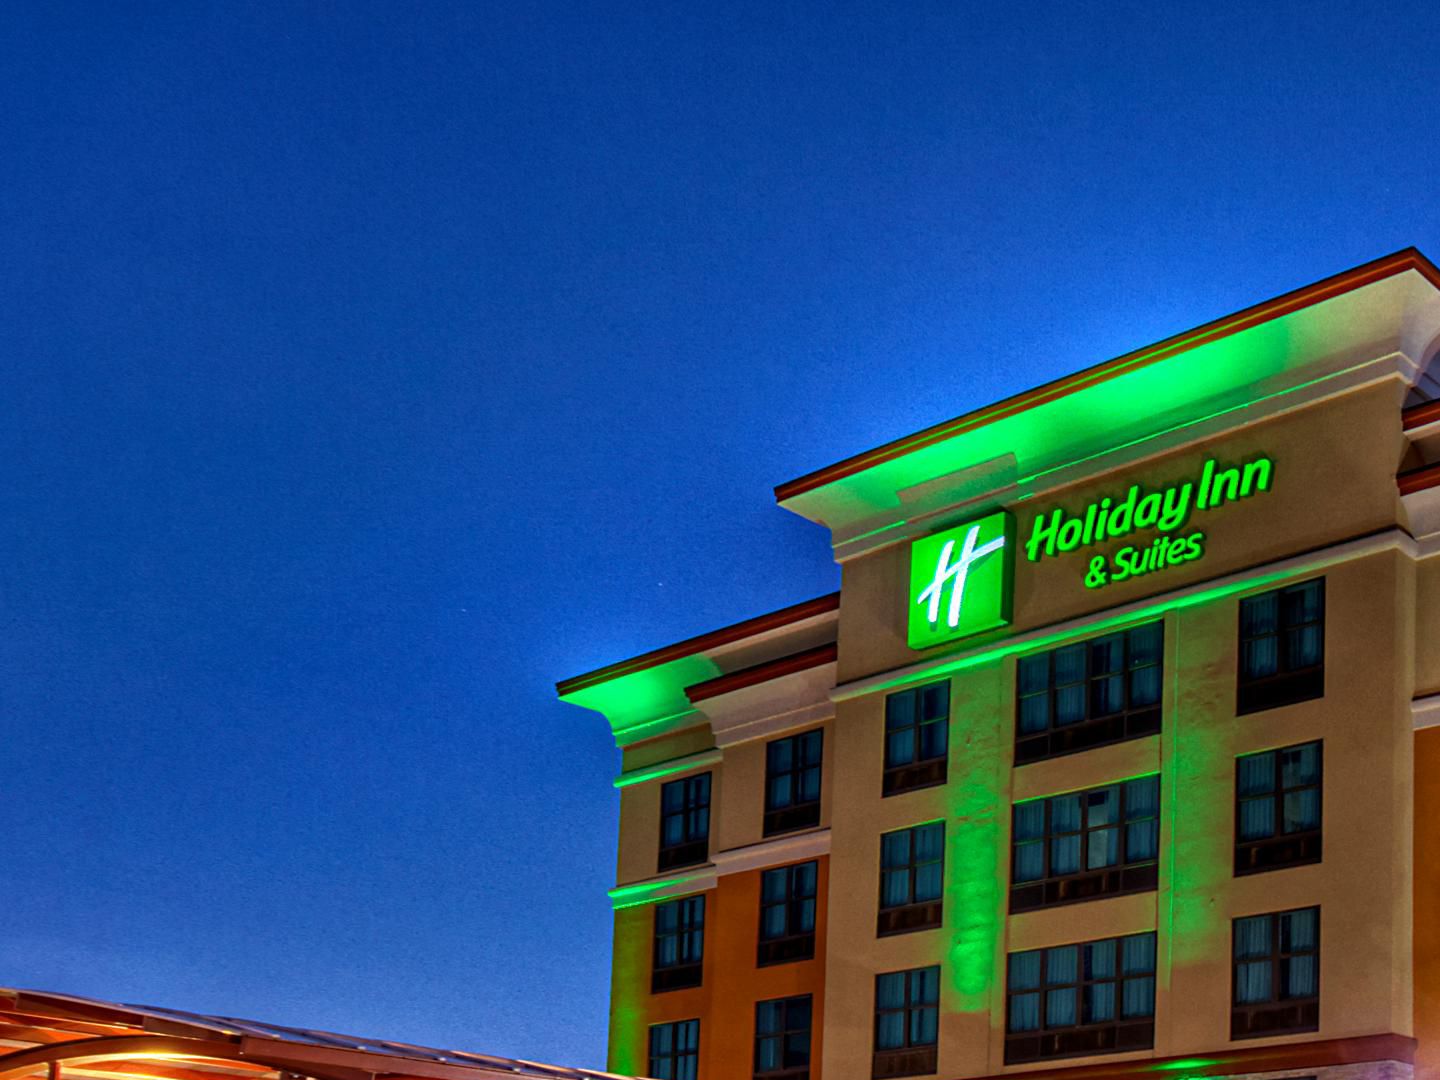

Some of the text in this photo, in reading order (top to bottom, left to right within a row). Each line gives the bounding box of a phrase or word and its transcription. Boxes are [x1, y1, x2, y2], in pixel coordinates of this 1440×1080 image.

[1025, 457, 1274, 562] Holiday Inn
[1084, 532, 1203, 588] & Suites
